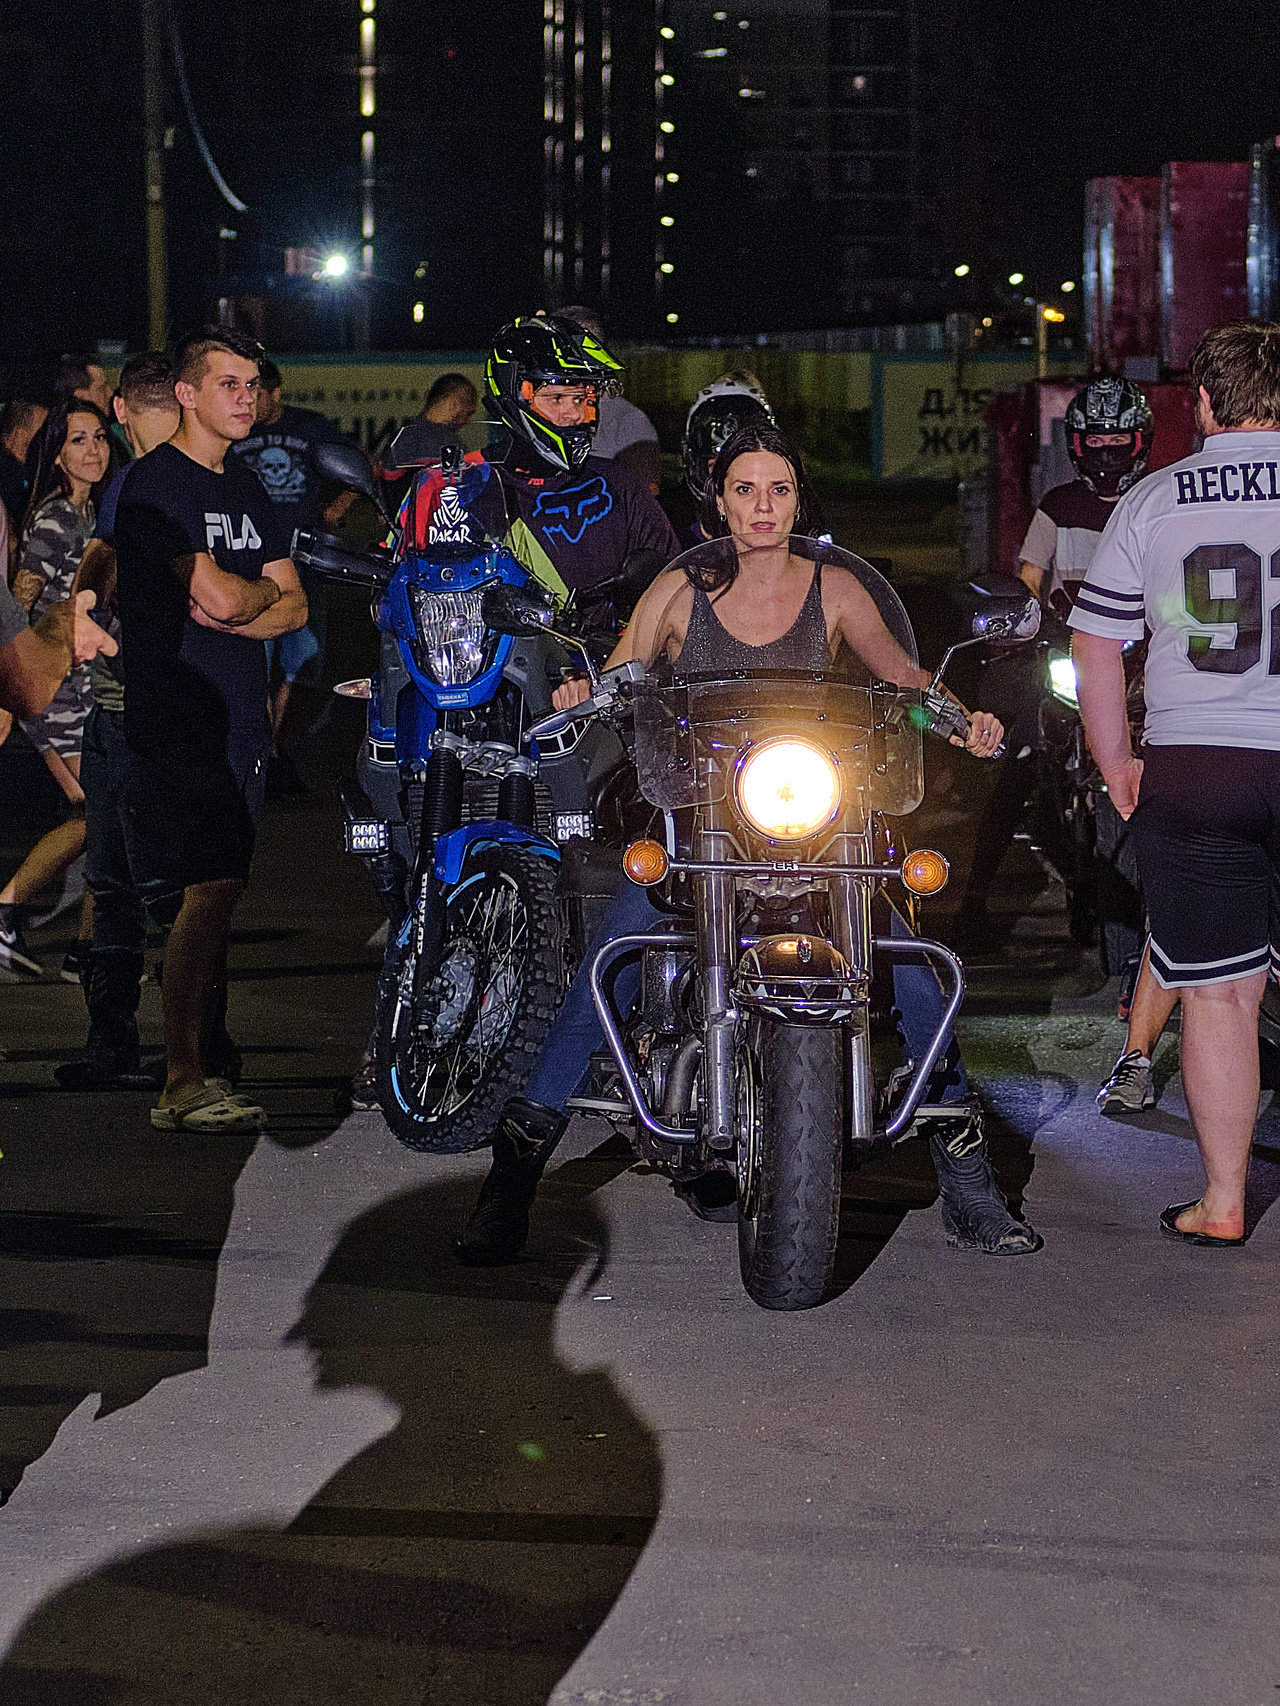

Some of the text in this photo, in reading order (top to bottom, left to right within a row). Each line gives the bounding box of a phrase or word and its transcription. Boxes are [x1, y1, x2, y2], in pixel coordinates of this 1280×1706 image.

[204, 512, 262, 551] FILA
[428, 524, 473, 545] DAKAR
[416, 872, 429, 956] DUNLOP
